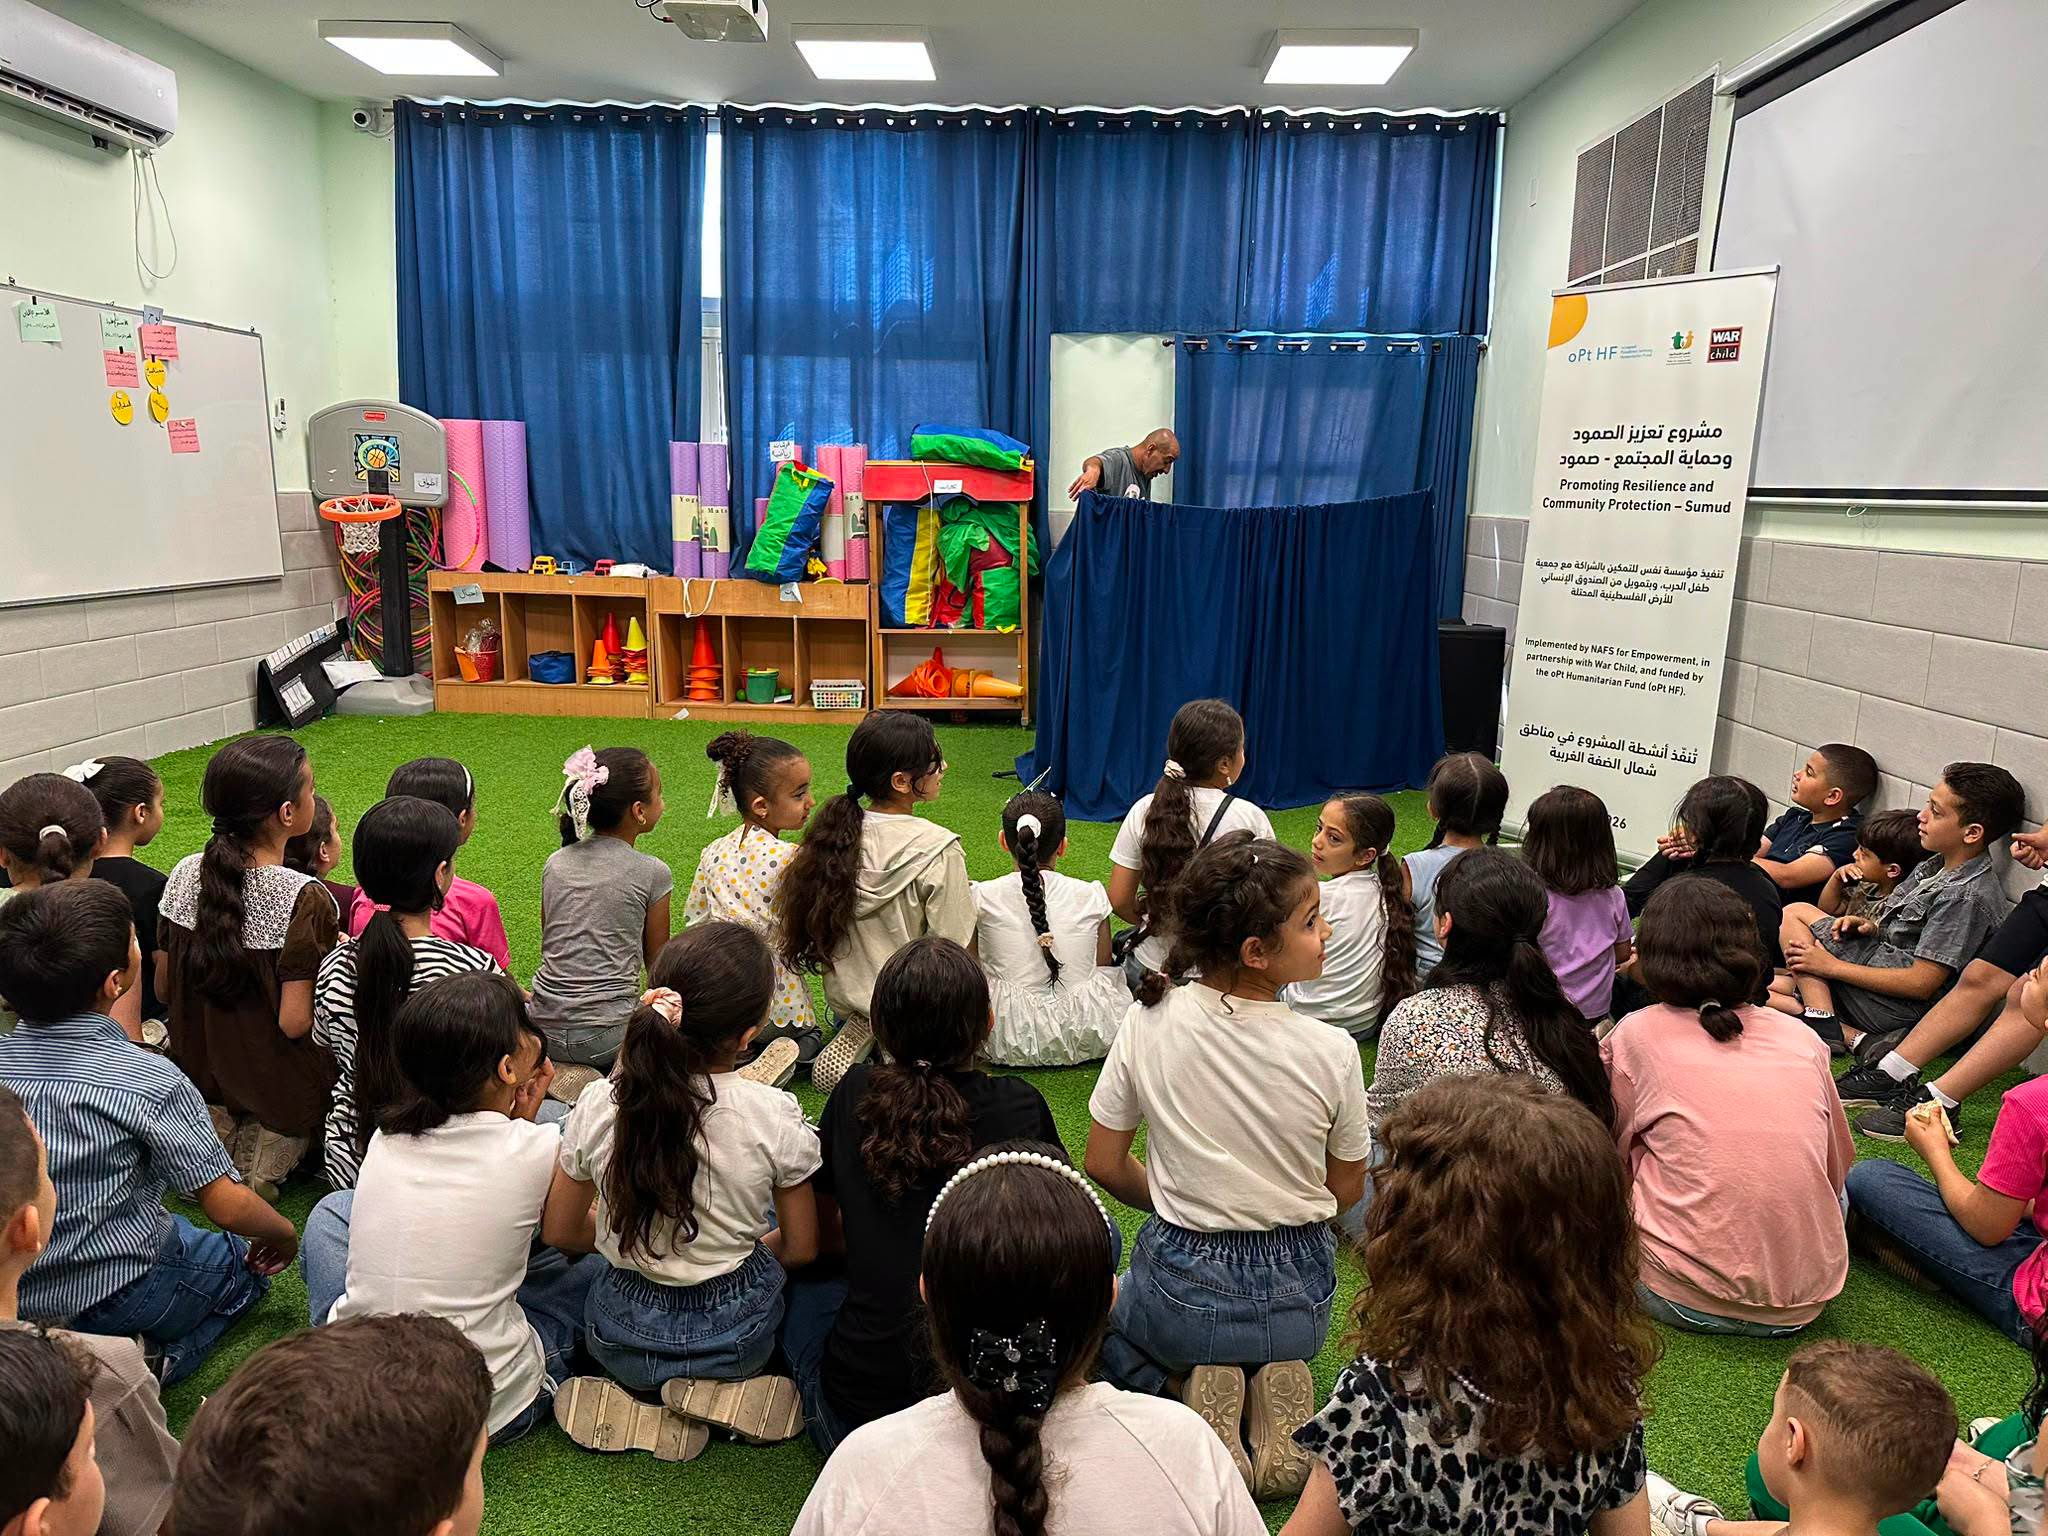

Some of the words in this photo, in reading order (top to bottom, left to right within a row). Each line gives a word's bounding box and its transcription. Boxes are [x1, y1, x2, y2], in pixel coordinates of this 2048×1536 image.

[1713, 331, 1740, 343] WAR
[1568, 348, 1592, 363] oPt
[1596, 346, 1618, 360] HF
[1710, 347, 1737, 360] child
[1573, 425, 1625, 444] الصمود
[1627, 424, 1665, 443] تعزيز
[1667, 420, 1723, 443] مشروع
[1559, 454, 1600, 469] صمود
[1614, 449, 1675, 469] المجتمع
[1678, 449, 1732, 469] وحماية
[1560, 478, 1620, 493] Promoting
[1623, 479, 1687, 492] Resilience
[1689, 480, 1715, 493] and
[1542, 497, 1606, 512] Community
[1608, 499, 1672, 512] Protection
[1685, 500, 1731, 513] Sumud
[1535, 558, 1559, 570] جمعية
[1560, 562, 1572, 570] مع
[1574, 560, 1606, 572] بالشراكة
[1607, 563, 1639, 574] للتمكين
[1640, 565, 1662, 576] نفس
[1540, 572, 1574, 584] الإنساني
[1575, 574, 1608, 585] الصندوق
[1663, 566, 1698, 579] مؤسسة
[1700, 568, 1725, 580] تنفيذ
[1610, 578, 1622, 587] من
[1624, 578, 1658, 591] وبتمويل
[1687, 582, 1710, 594] طفل
[1570, 587, 1598, 598] المحتلة
[1600, 589, 1646, 602] الفلسطينية
[1648, 592, 1673, 605] للأرض
[1525, 637, 1578, 651] Implemented
[1579, 643, 1589, 654] by
[1590, 644, 1615, 656] NAFS
[1616, 647, 1629, 657] for
[1631, 649, 1699, 666] Empowerment,
[1701, 657, 1711, 667] in
[1526, 653, 1574, 666] partnership
[1575, 658, 1593, 667] with
[1594, 660, 1612, 670] War
[1613, 662, 1638, 674] Child,
[1640, 667, 1657, 676] and
[1659, 668, 1690, 680] funded
[1692, 672, 1704, 683] by
[1535, 667, 1549, 677] the
[1550, 669, 1565, 679] oPt
[1566, 671, 1622, 687] Humanitarian
[1624, 679, 1646, 690] Fund
[1648, 681, 1666, 693] (oPt
[1668, 685, 1686, 697] HF).
[1519, 723, 1555, 739] مناطق
[1557, 731, 1575, 746] في
[1577, 735, 1625, 751] المشروع
[1628, 741, 1669, 759] أنشطة
[1549, 746, 1584, 763] الغربية
[1587, 753, 1621, 770] الضفة
[1623, 760, 1657, 777] شمال
